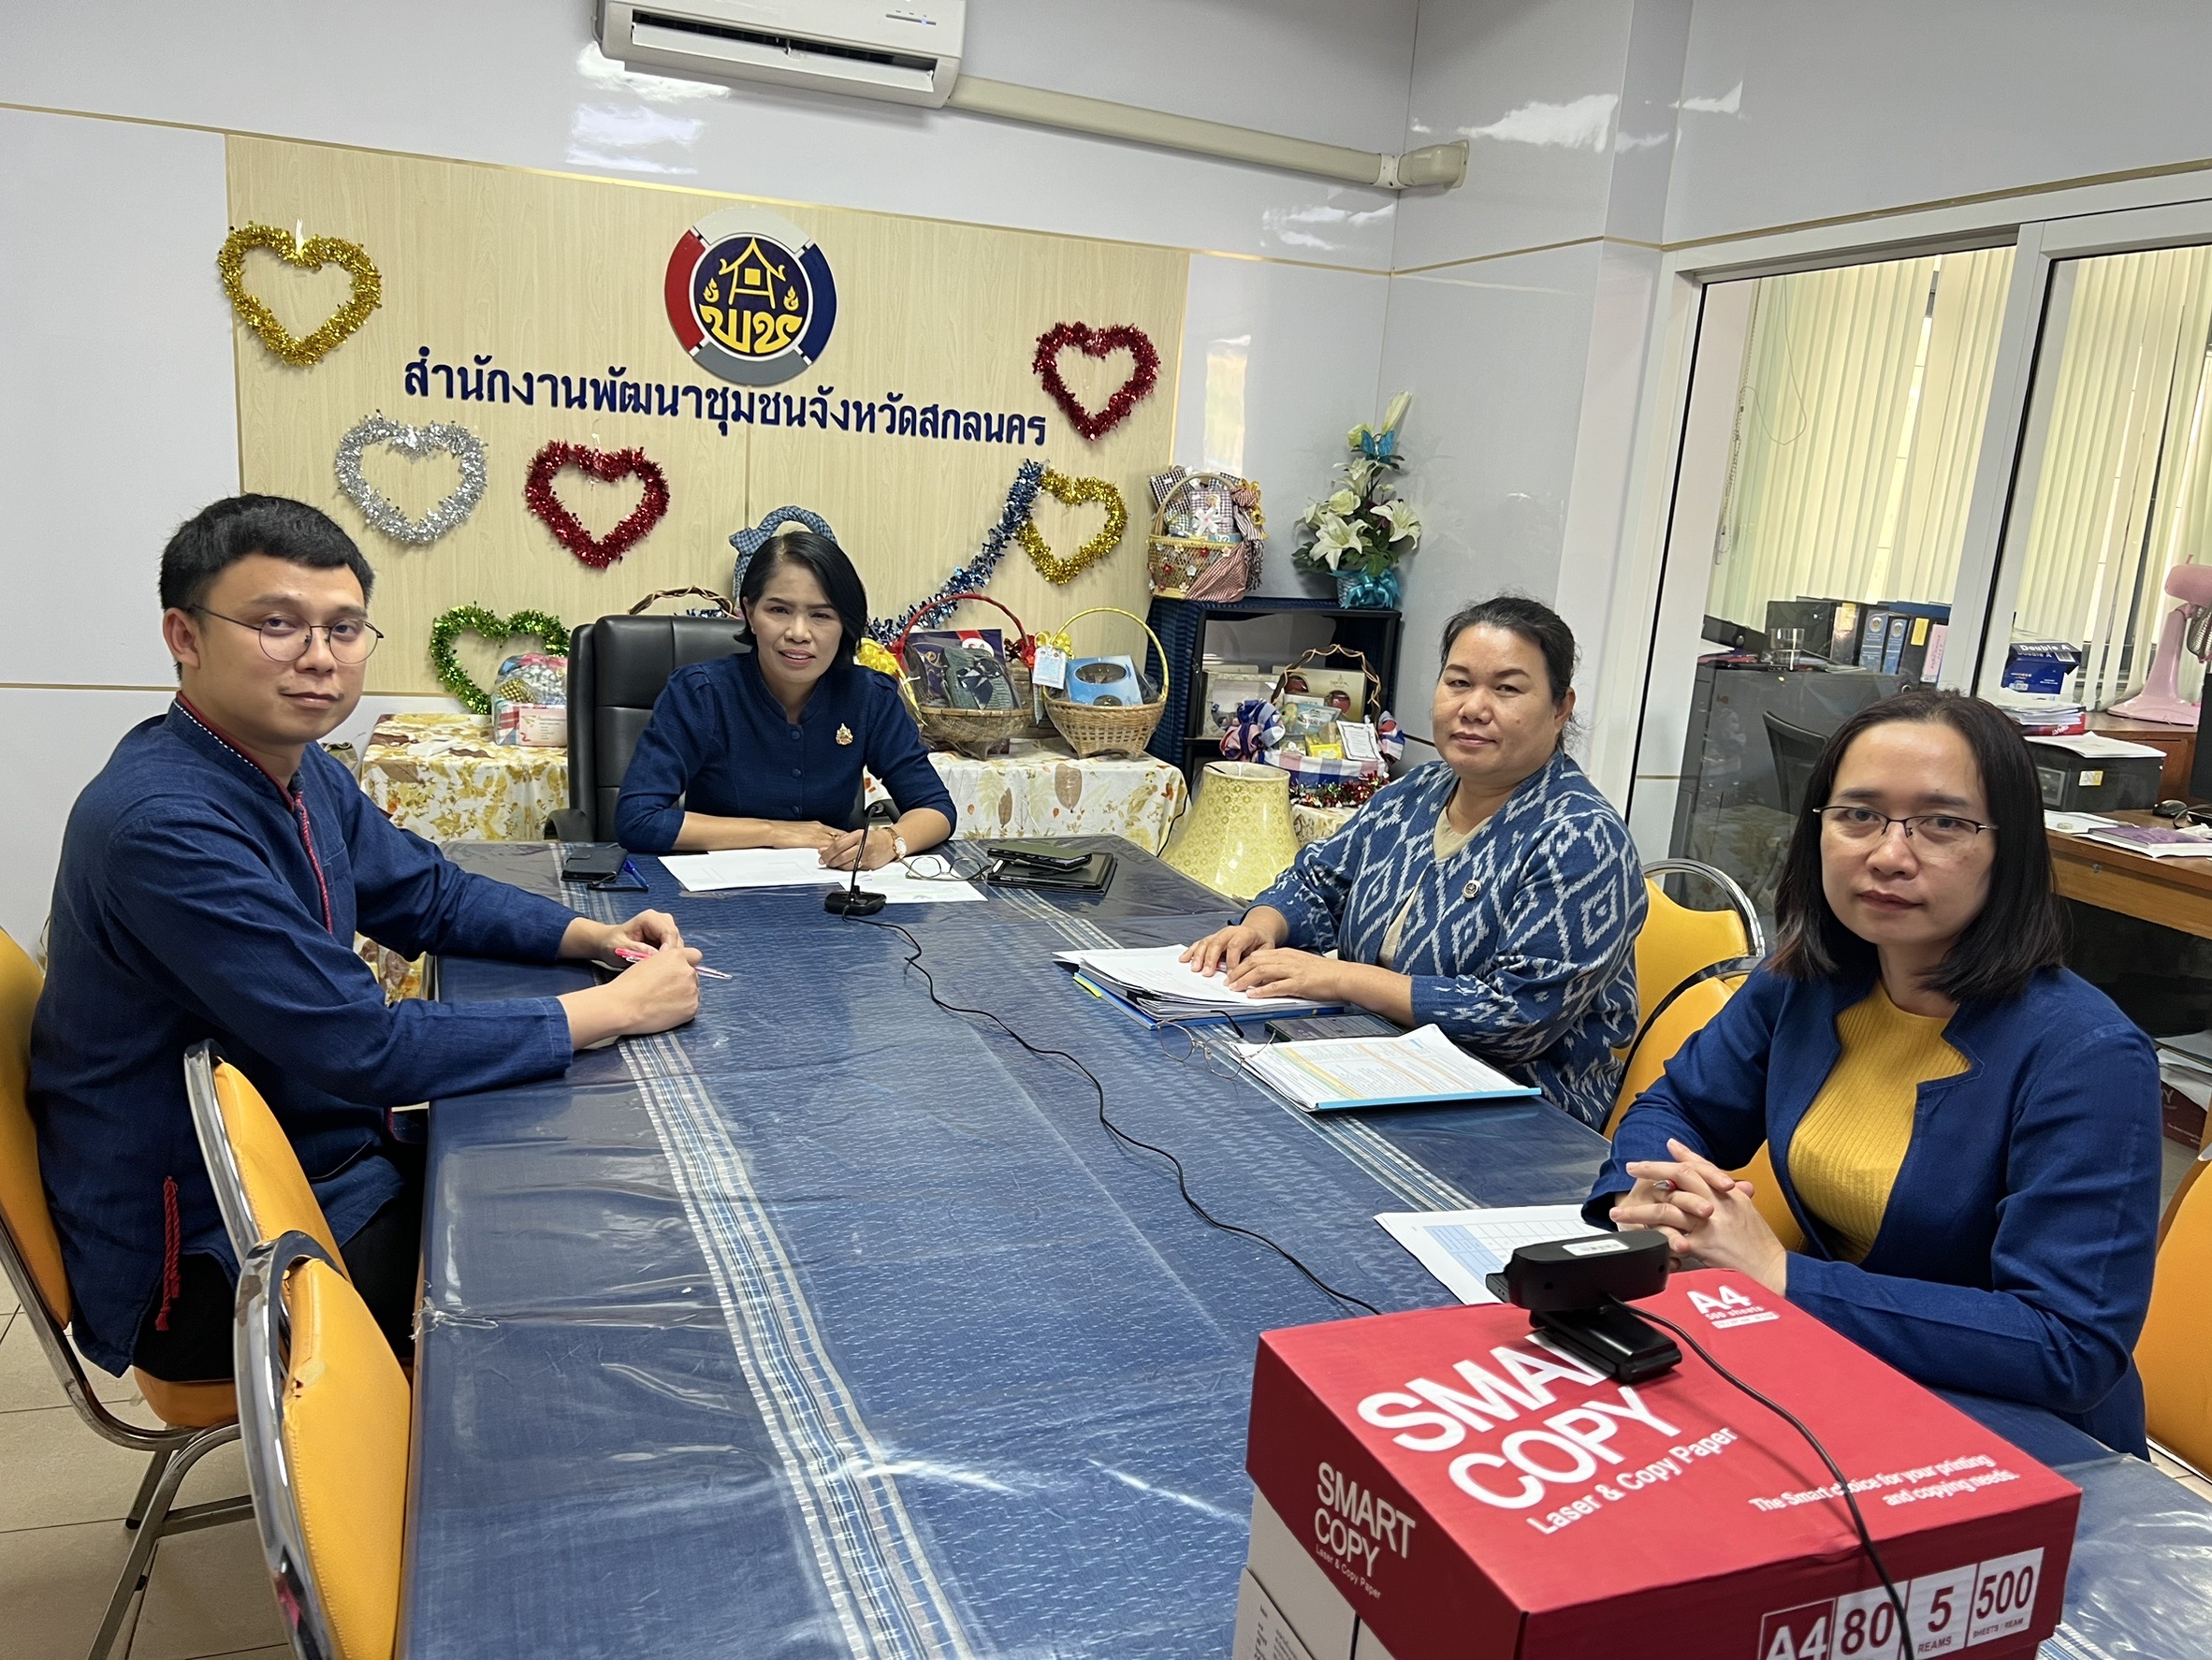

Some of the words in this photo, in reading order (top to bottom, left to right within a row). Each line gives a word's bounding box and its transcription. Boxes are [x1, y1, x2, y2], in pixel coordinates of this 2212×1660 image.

[403, 346, 1047, 447] สำนักงานพัฒนาชุมชนจังหวัดสกลนคร
[1687, 1285, 1752, 1315] A4
[1704, 1310, 1727, 1320] 500
[1726, 1305, 1765, 1318] sheets
[1358, 1333, 1612, 1452] SMA
[1448, 1385, 1682, 1509] COPY
[1526, 1494, 1604, 1535] Laser
[1594, 1483, 1626, 1502] &
[1616, 1457, 1683, 1490] Copy
[1668, 1427, 1739, 1464] Paper
[1748, 1497, 1787, 1512] The
[1781, 1486, 1834, 1507] Smart
[1829, 1478, 1883, 1496] coice
[1876, 1472, 1904, 1486] for
[1897, 1464, 1938, 1484] your
[1935, 1454, 1997, 1477] printing
[1882, 1491, 1916, 1507] and
[1913, 1479, 1976, 1499] copying
[1317, 1462, 1416, 1560] SMART
[1315, 1507, 1380, 1578] COPY
[1316, 1544, 1334, 1565] Laser
[1334, 1558, 1340, 1569] &
[1341, 1564, 1360, 1586] Copy
[1360, 1577, 1382, 1600] Paper
[1975, 1565, 2034, 1620] 500
[1840, 1601, 1895, 1656] 80
[1928, 1586, 1955, 1633] 5
[1972, 1624, 2000, 1638] SHEETS
[2004, 1617, 2024, 1629] REAM
[1767, 1616, 1828, 1660] A4
[1917, 1636, 1952, 1654] REAMS
